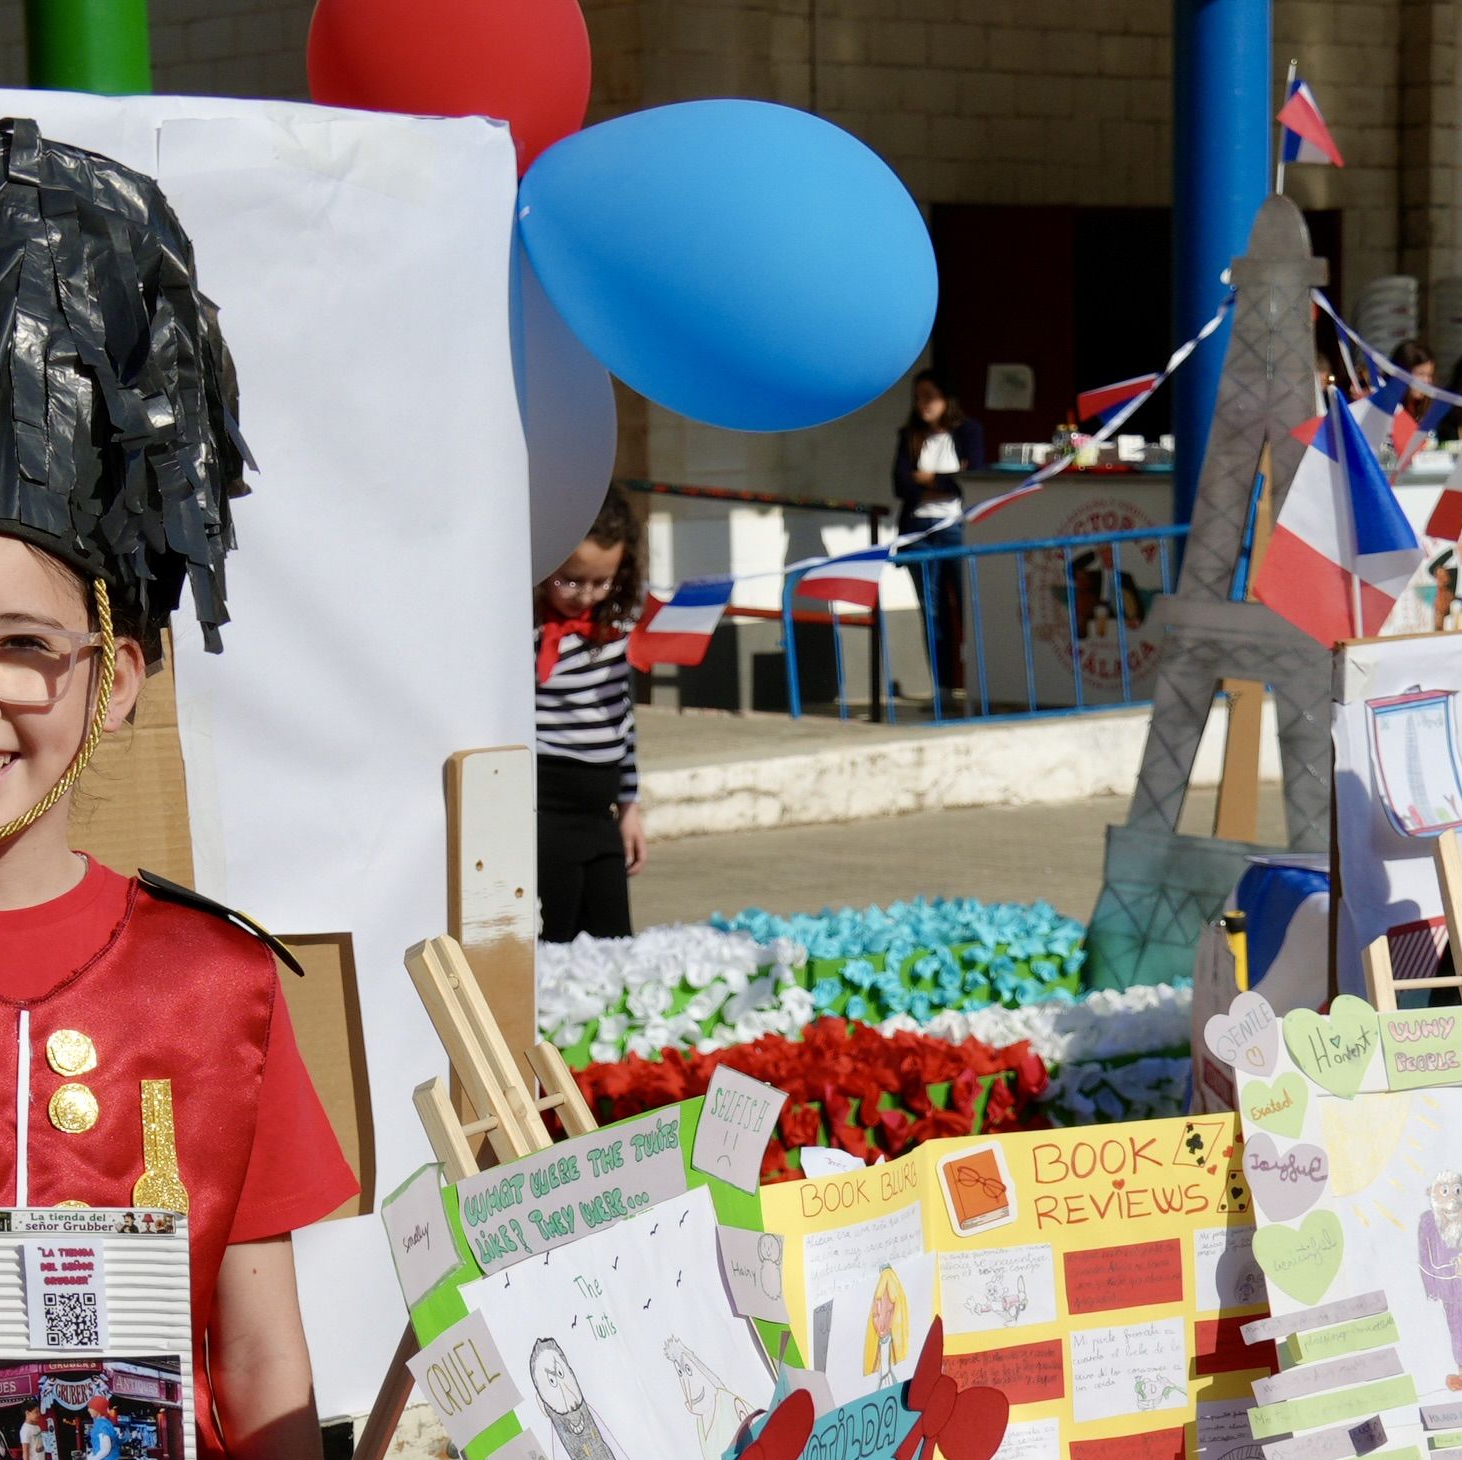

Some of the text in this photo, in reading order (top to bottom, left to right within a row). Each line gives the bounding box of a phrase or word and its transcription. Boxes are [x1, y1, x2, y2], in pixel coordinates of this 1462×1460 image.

[1388, 1015, 1456, 1043] WHY
[586, 1140, 626, 1179] THE
[1033, 1136, 1164, 1184] BOOK
[799, 1177, 870, 1218] BOOK
[25, 1221, 115, 1232] señor Grubber
[29, 1212, 107, 1222] La tienda del
[573, 1273, 603, 1299] The
[585, 1311, 618, 1342] Twits
[425, 1337, 501, 1418] CRUEL
